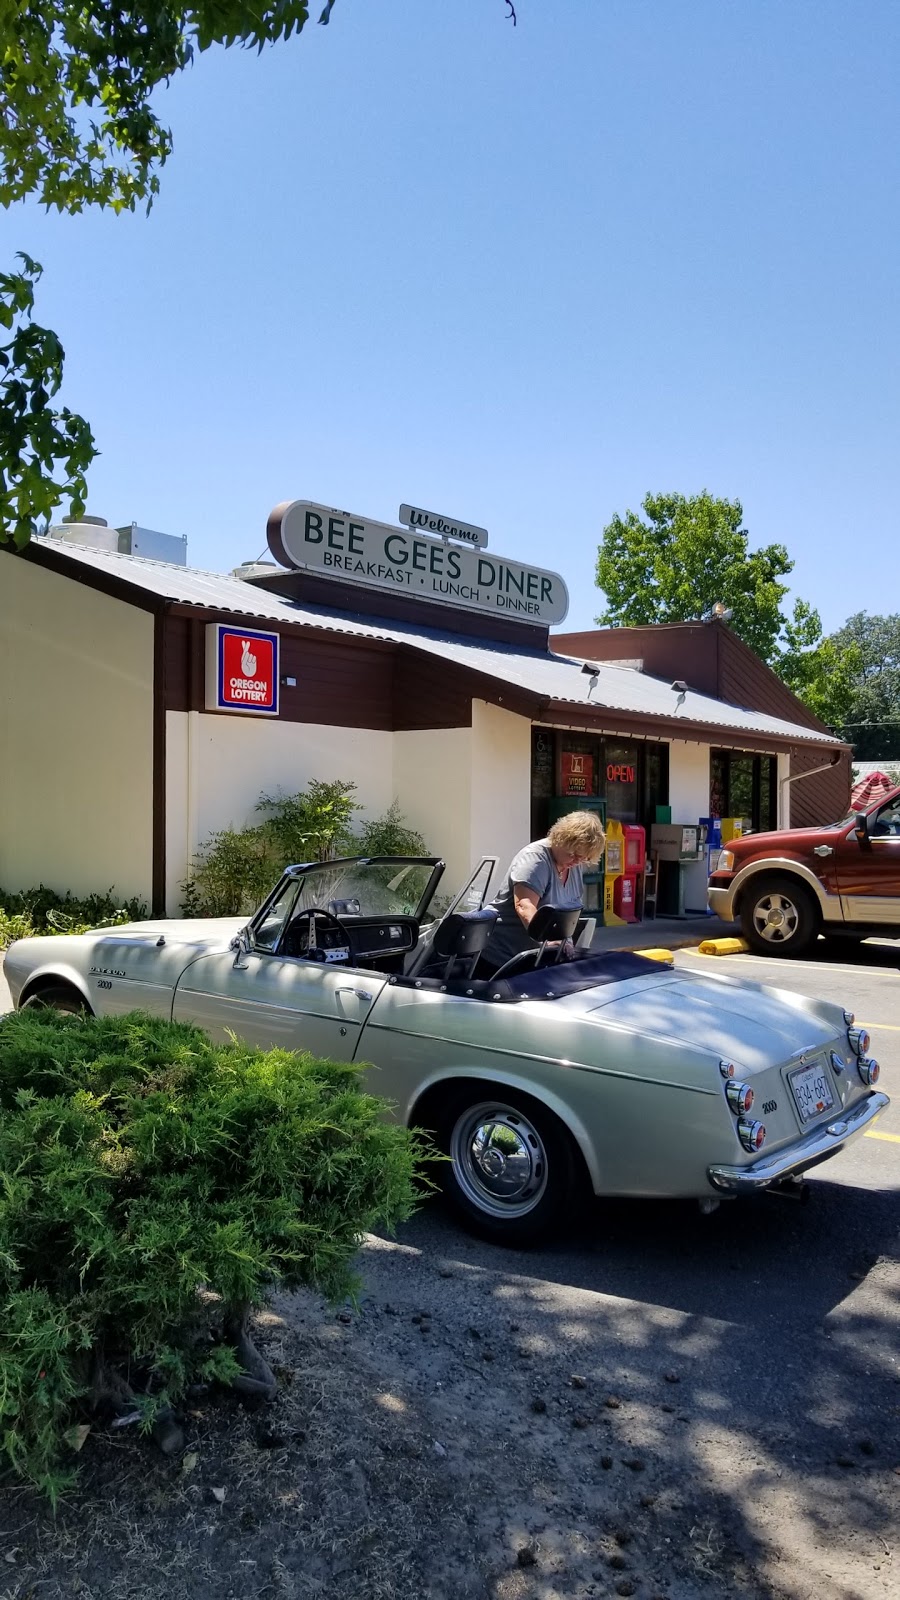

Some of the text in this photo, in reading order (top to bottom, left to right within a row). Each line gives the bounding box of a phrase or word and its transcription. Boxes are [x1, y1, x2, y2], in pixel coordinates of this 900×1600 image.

[410, 510, 479, 543] Welcome
[304, 511, 554, 605] BEE GEES DINER
[323, 551, 541, 616] BREAKFAST LUNCH DINNER
[229, 677, 267, 692] OREGON
[231, 688, 266, 702] LOTTERY
[606, 764, 635, 783] OPEN
[568, 777, 586, 786] VIDEO
[90, 967, 126, 976] DATSUN
[97, 980, 112, 990] 2000
[762, 1100, 777, 1114] 2000
